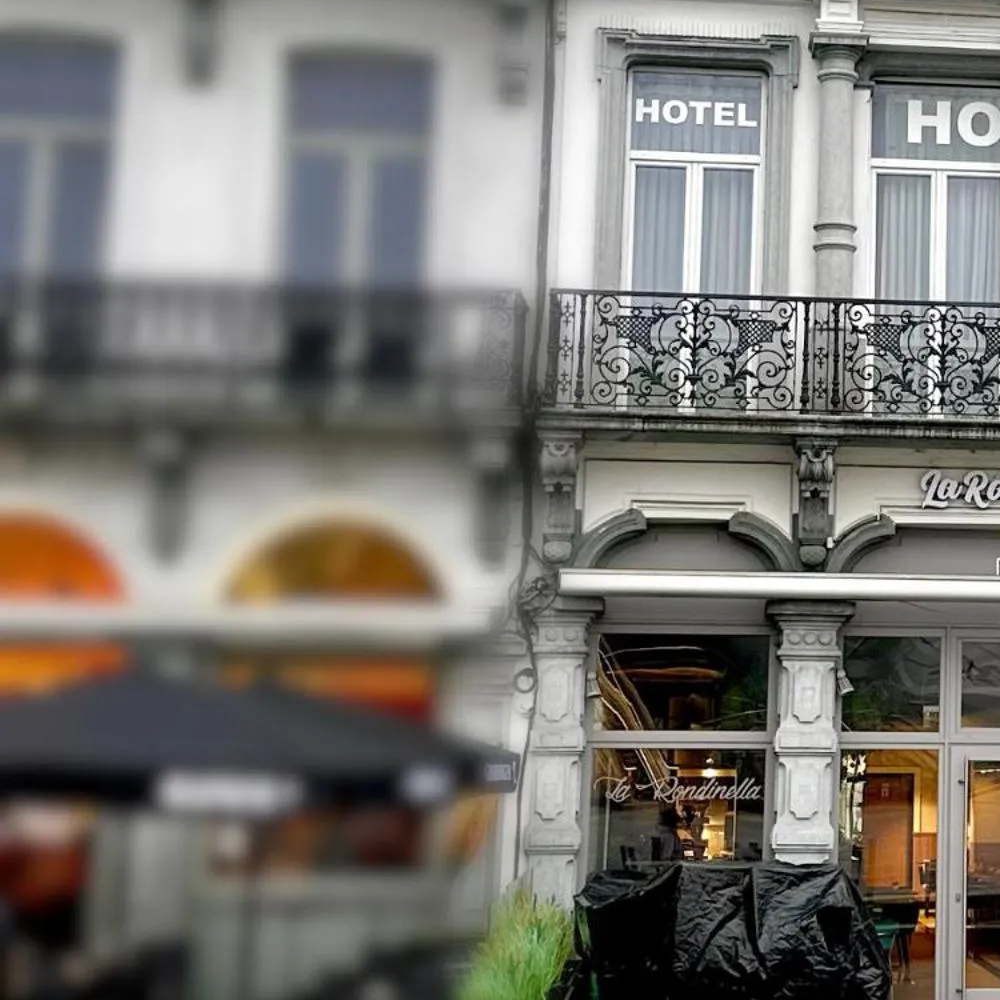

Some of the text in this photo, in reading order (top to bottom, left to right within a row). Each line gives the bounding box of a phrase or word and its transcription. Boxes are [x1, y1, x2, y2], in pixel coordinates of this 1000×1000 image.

[635, 98, 758, 127] HOTEL
[920, 470, 964, 509] La
[635, 776, 762, 803] Rondinella
